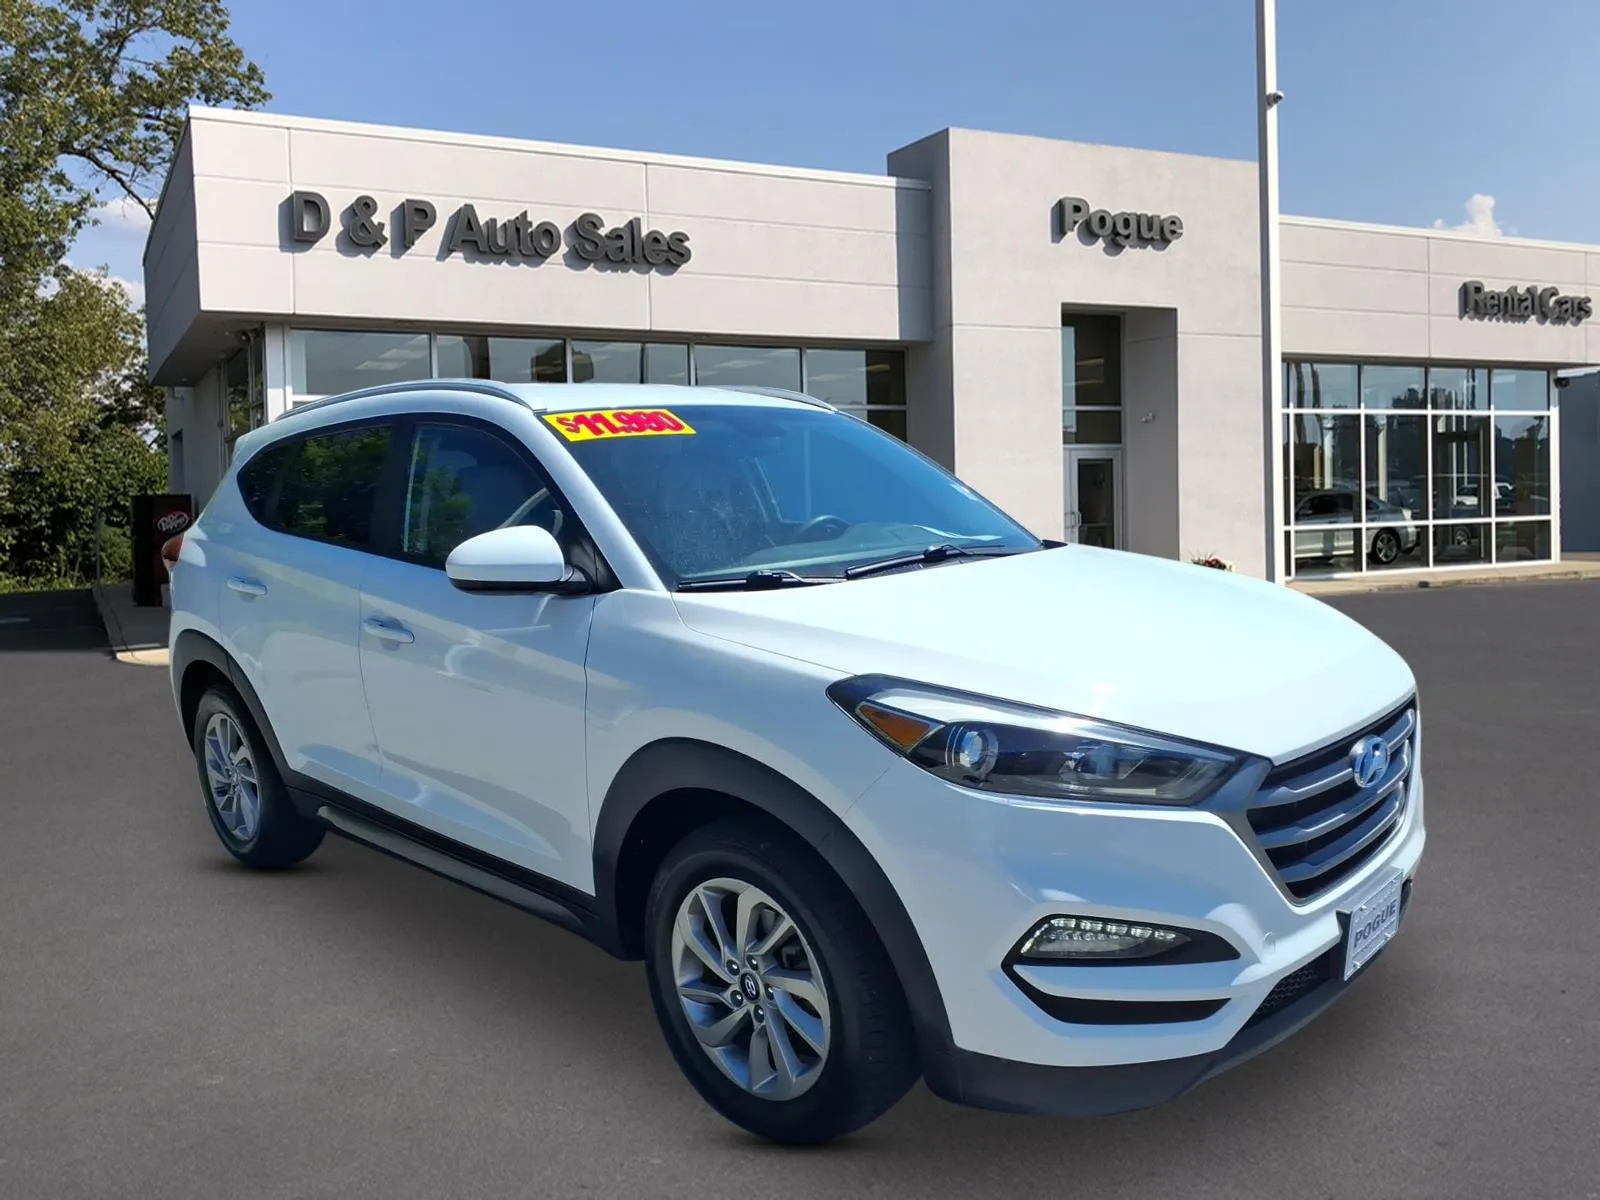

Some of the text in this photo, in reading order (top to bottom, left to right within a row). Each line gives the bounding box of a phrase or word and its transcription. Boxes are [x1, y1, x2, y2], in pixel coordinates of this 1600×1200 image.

[288, 190, 692, 268] D & P Auto Sales
[1057, 196, 1184, 251] Pogue
[1461, 280, 1592, 324] Rental Cars
[1354, 898, 1398, 948] POGUE
